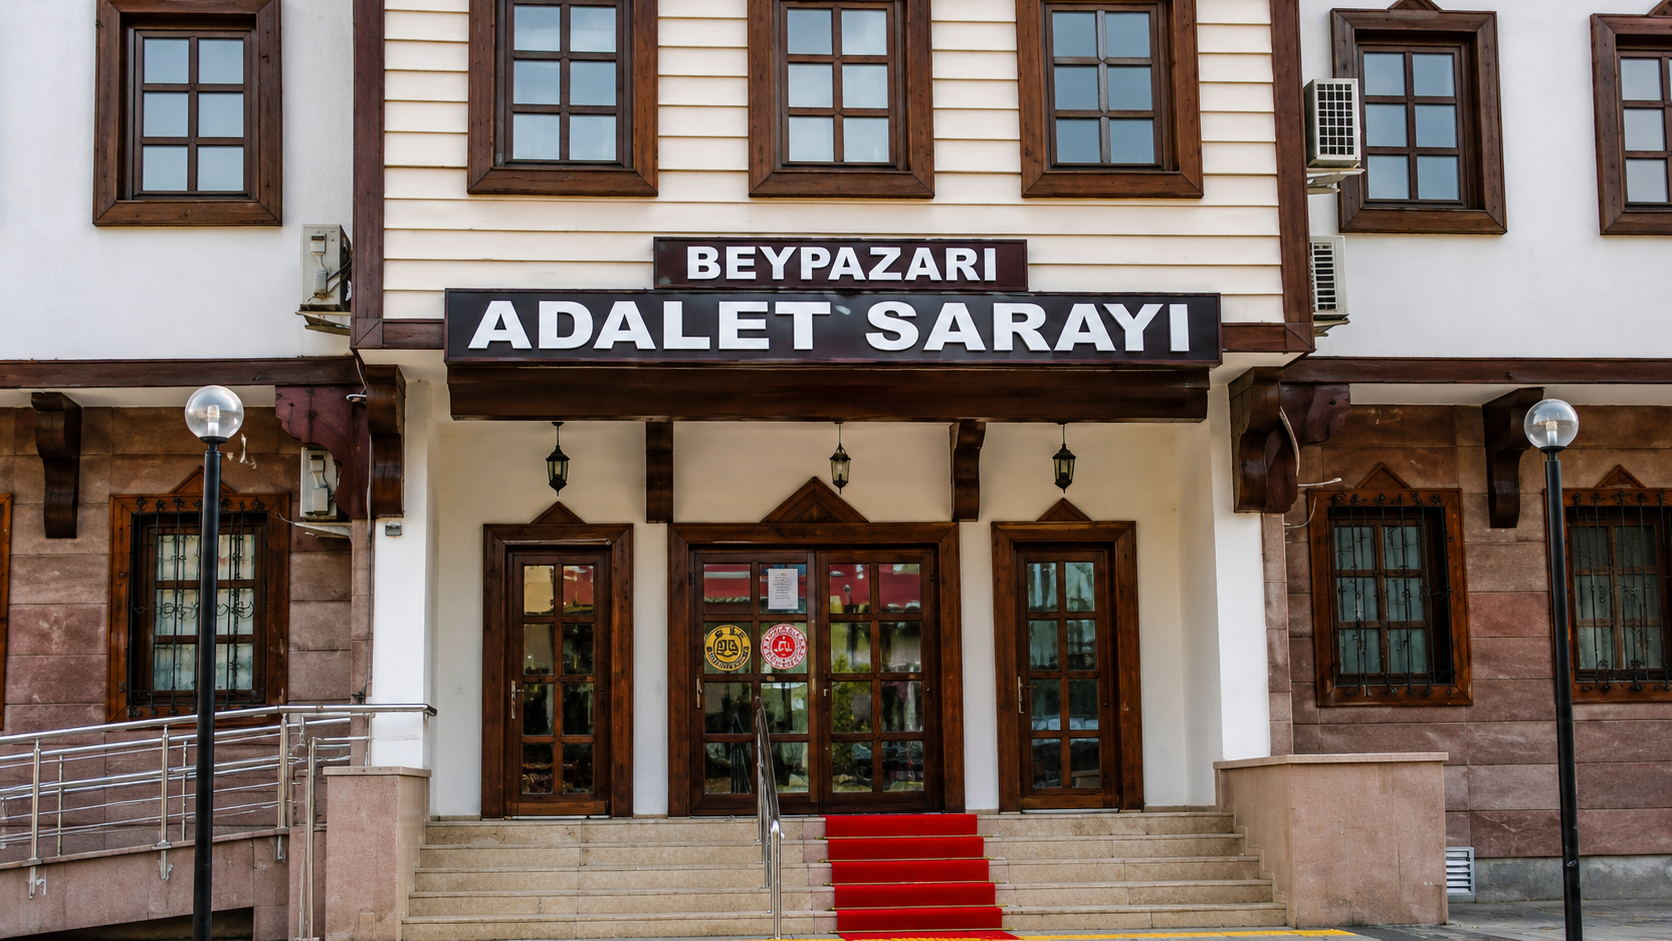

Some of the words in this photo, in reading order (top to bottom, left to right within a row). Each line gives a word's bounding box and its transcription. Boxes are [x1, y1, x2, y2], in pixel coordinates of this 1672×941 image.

[687, 246, 997, 281] BEYPAZARI
[468, 300, 831, 351] ADALET
[865, 301, 1190, 353] SARAYI
